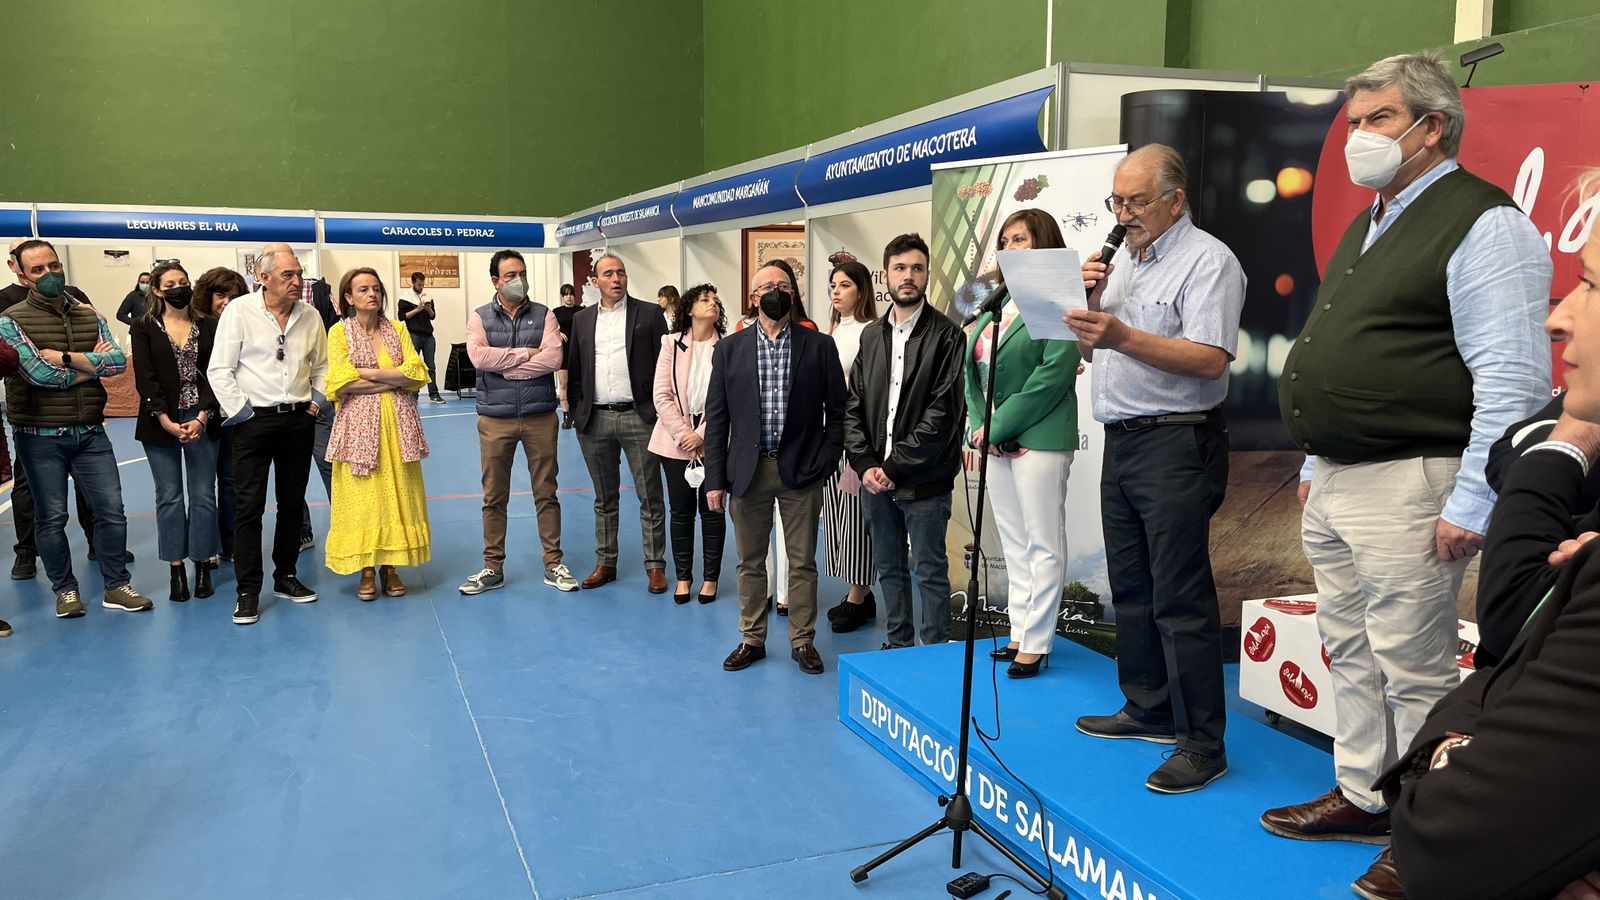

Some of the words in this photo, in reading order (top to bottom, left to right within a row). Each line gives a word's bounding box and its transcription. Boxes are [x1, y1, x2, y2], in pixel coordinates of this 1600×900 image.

[825, 147, 894, 181] AYUNTAMIENTO
[896, 143, 911, 164] DE
[912, 126, 977, 160] MACOTERA
[126, 219, 196, 231] LEGUMBRES
[199, 221, 213, 232] EL
[215, 222, 239, 232] RUA
[382, 226, 442, 236] CARACOLES
[444, 228, 454, 237] D.
[457, 228, 495, 238] PEDRAZ
[861, 688, 972, 797] DIPUTACIÓN
[979, 772, 1009, 824] DE
